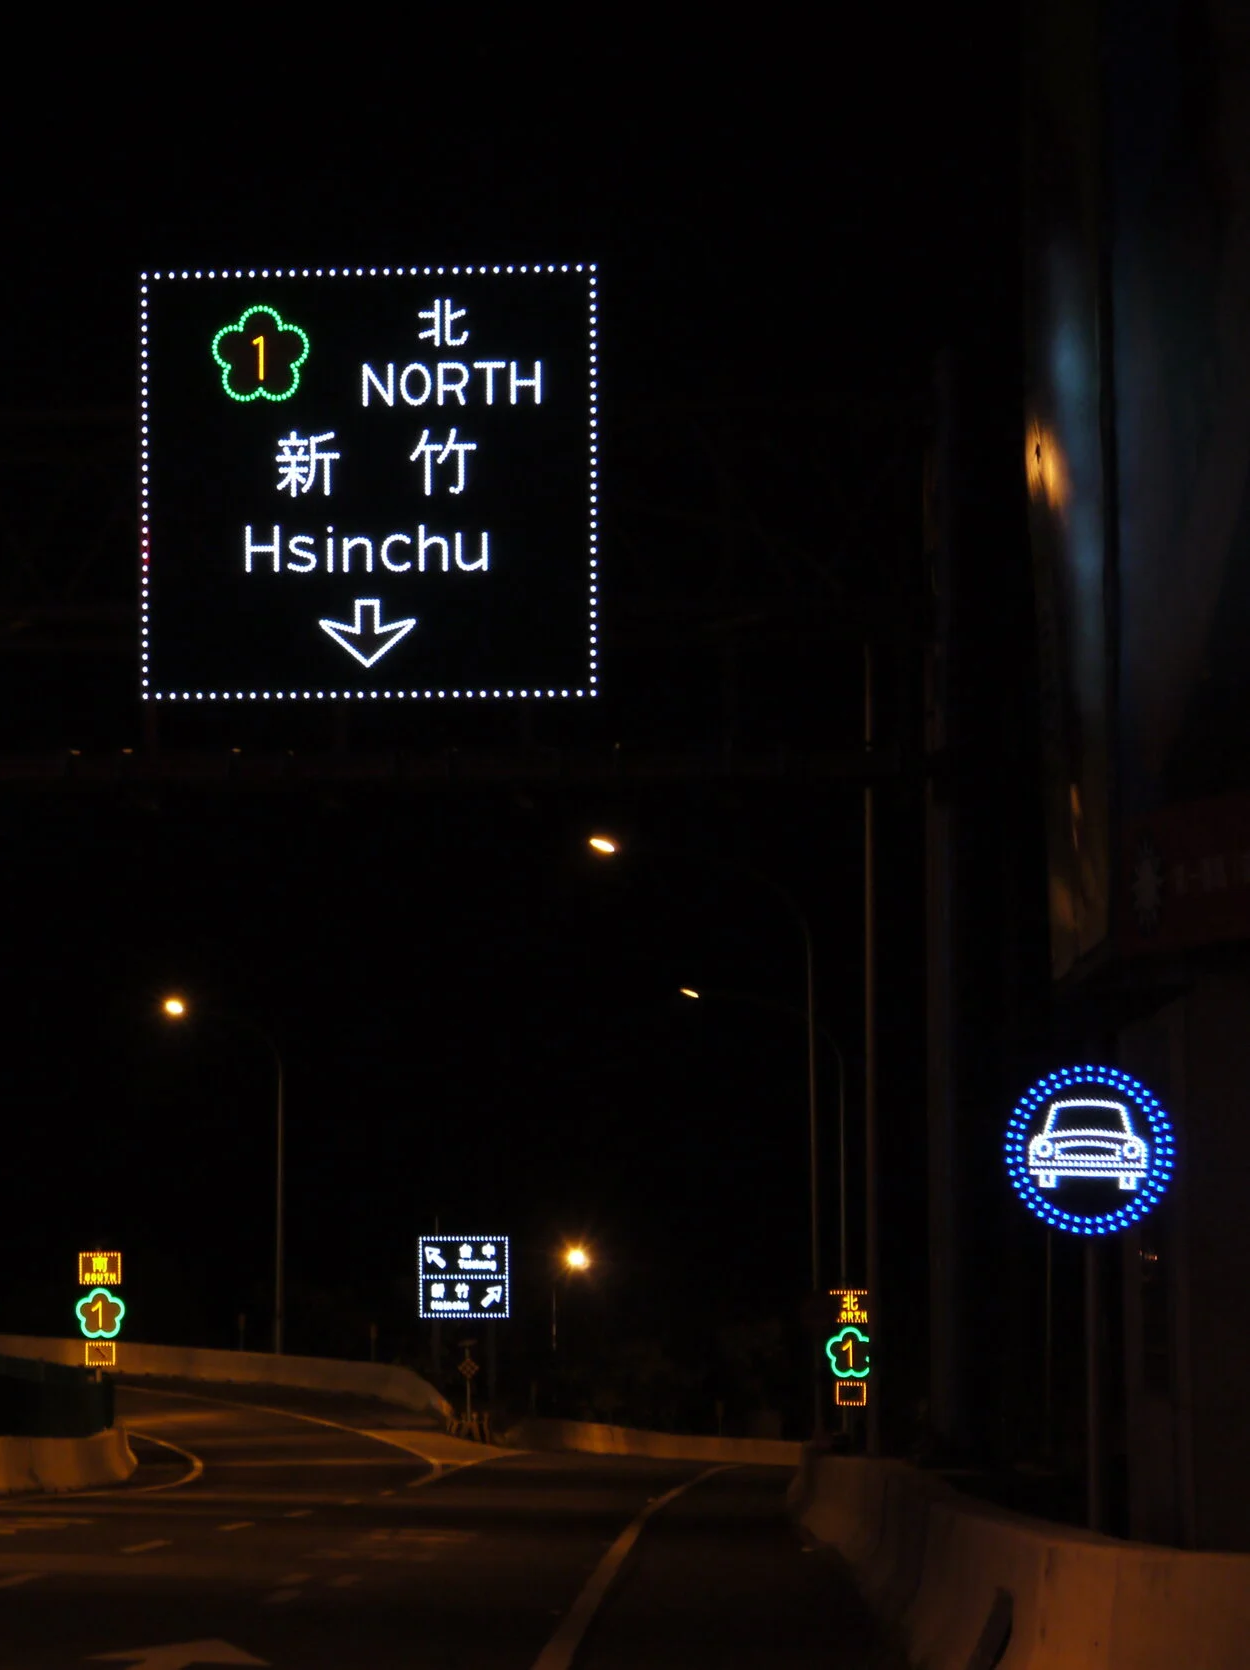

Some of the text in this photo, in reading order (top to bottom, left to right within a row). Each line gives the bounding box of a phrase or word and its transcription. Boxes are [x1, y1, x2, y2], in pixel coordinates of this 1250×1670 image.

[418, 299, 470, 347] 北
[251, 335, 266, 381] 1
[361, 360, 543, 408] NORTH
[244, 524, 491, 574] Hsinchu
[84, 1273, 117, 1283] SOUTH
[91, 1300, 103, 1329] 1
[840, 1310, 868, 1321] ORTH
[842, 1293, 859, 1311] 北
[841, 1338, 853, 1368] 1
